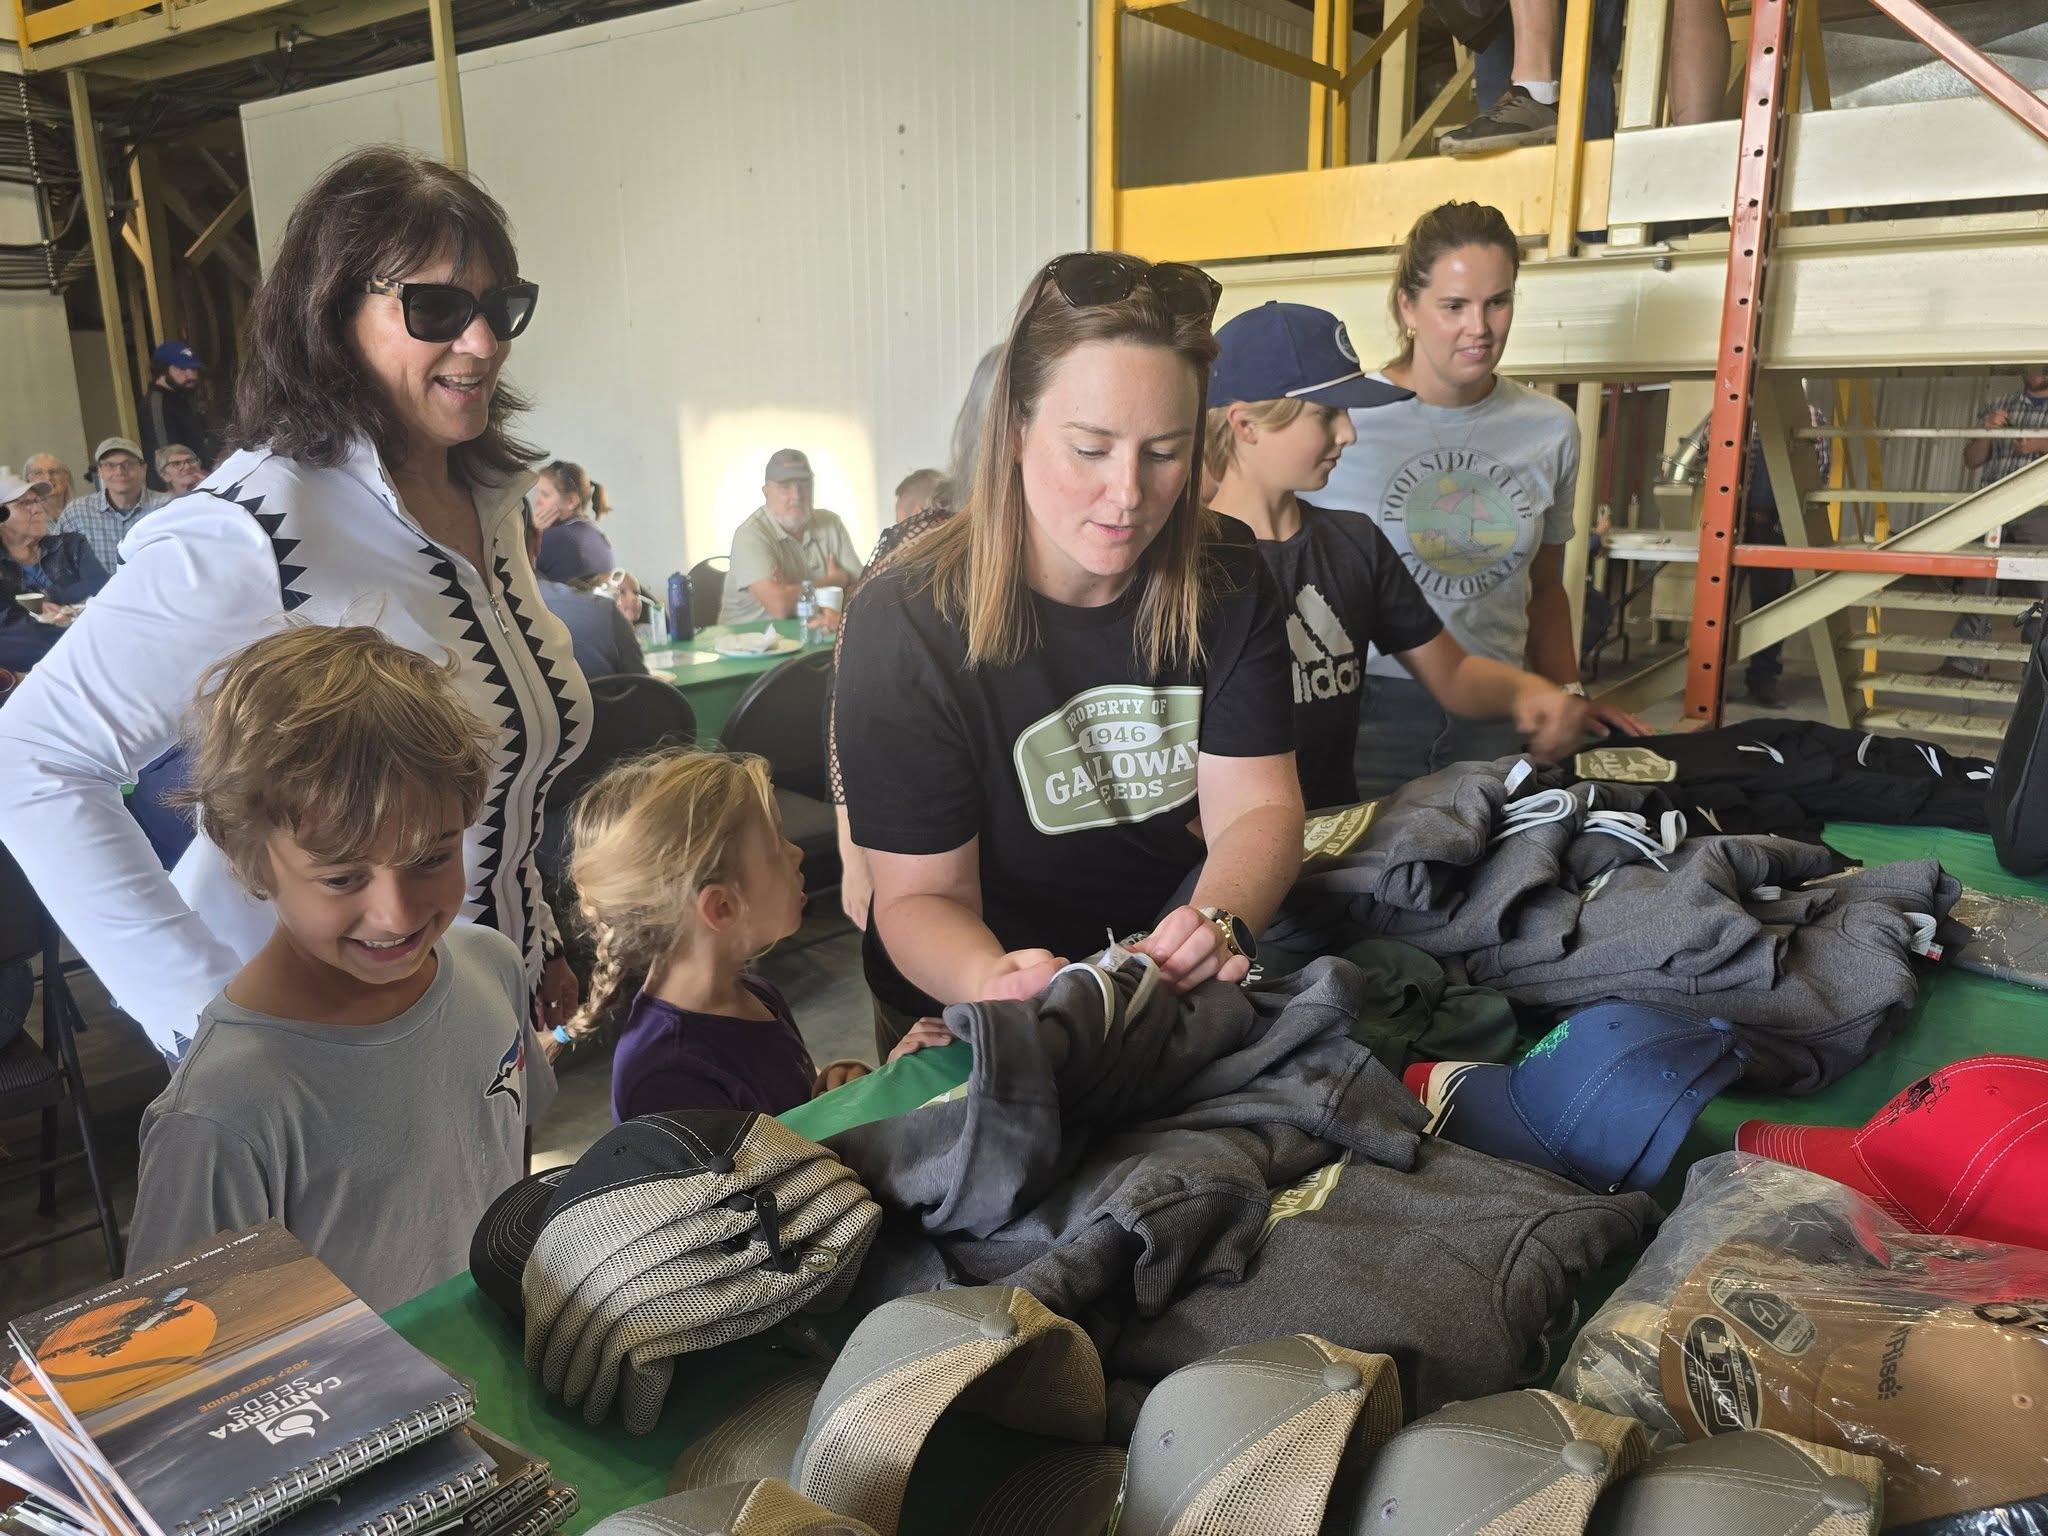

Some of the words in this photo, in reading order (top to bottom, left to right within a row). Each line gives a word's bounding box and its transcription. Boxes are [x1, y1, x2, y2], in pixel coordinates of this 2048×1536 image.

[1384, 452, 1478, 523] POOLSIDE
[1066, 699, 1144, 731] PROPERTY
[1152, 699, 1166, 715] OF
[1085, 726, 1147, 748] 1946
[226, 1376, 310, 1420] SEEDS
[241, 1375, 276, 1395] SEED
[197, 1391, 240, 1413] GUIDE
[207, 1376, 342, 1440] CANTERRA
